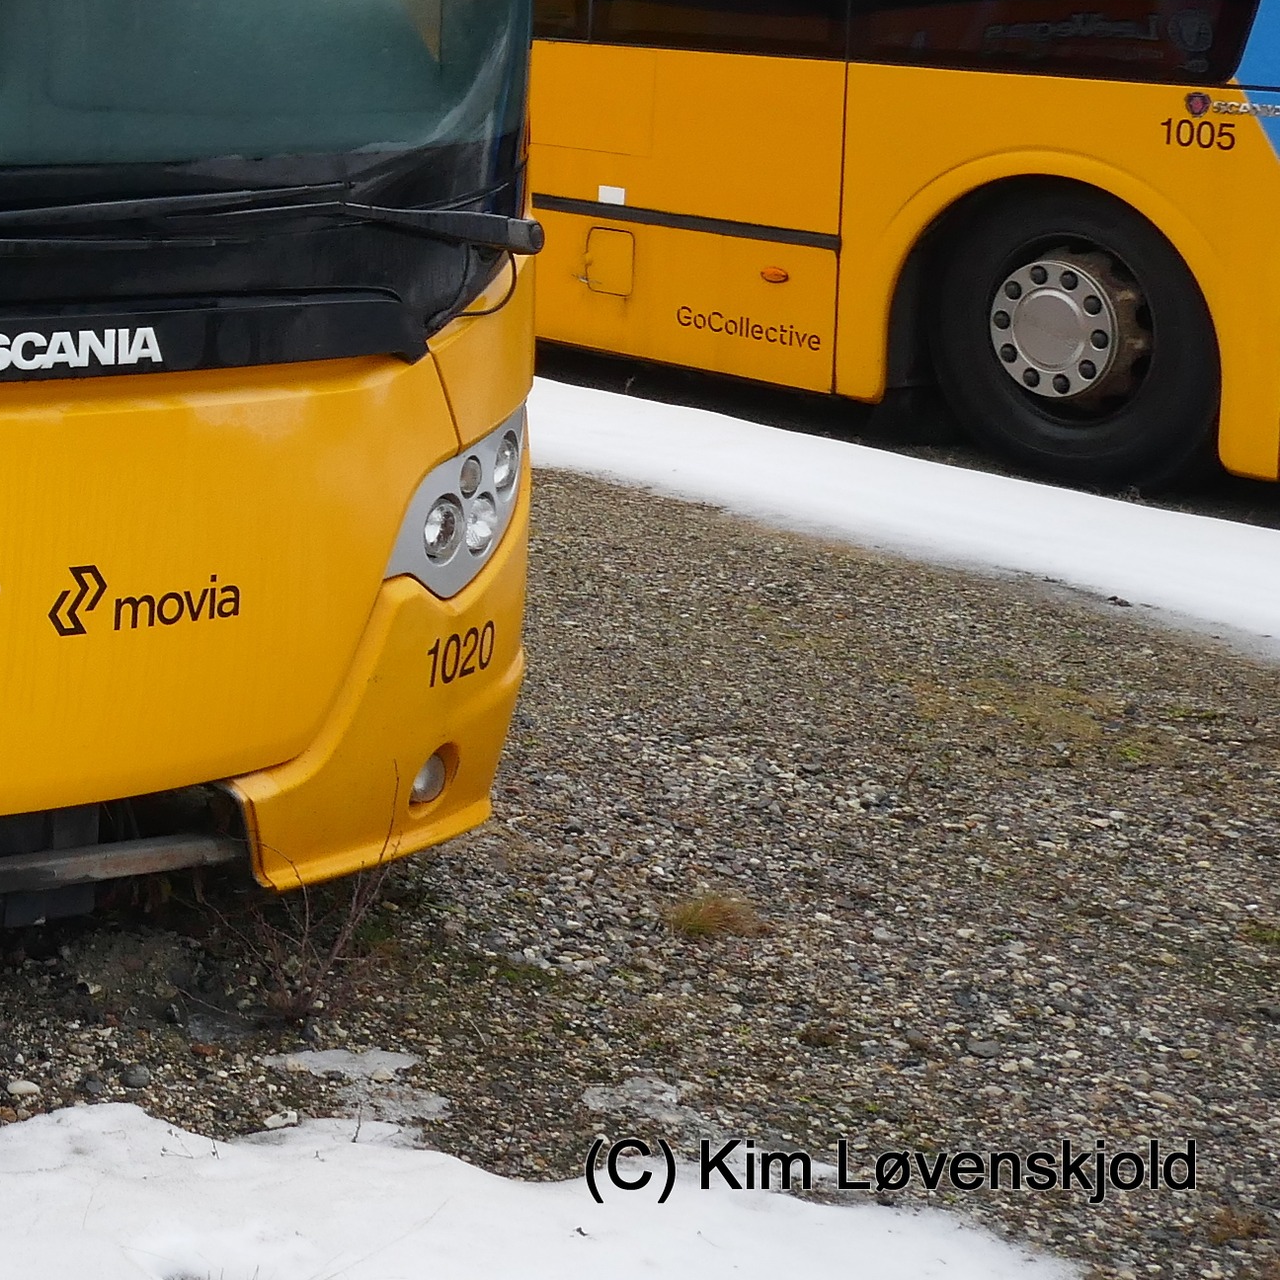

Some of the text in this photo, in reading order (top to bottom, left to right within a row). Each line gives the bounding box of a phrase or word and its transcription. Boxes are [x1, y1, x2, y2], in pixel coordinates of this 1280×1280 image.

[1161, 118, 1236, 151] 1005
[676, 305, 821, 351] GoCollective
[113, 574, 240, 631] movia
[427, 619, 495, 689] 1020
